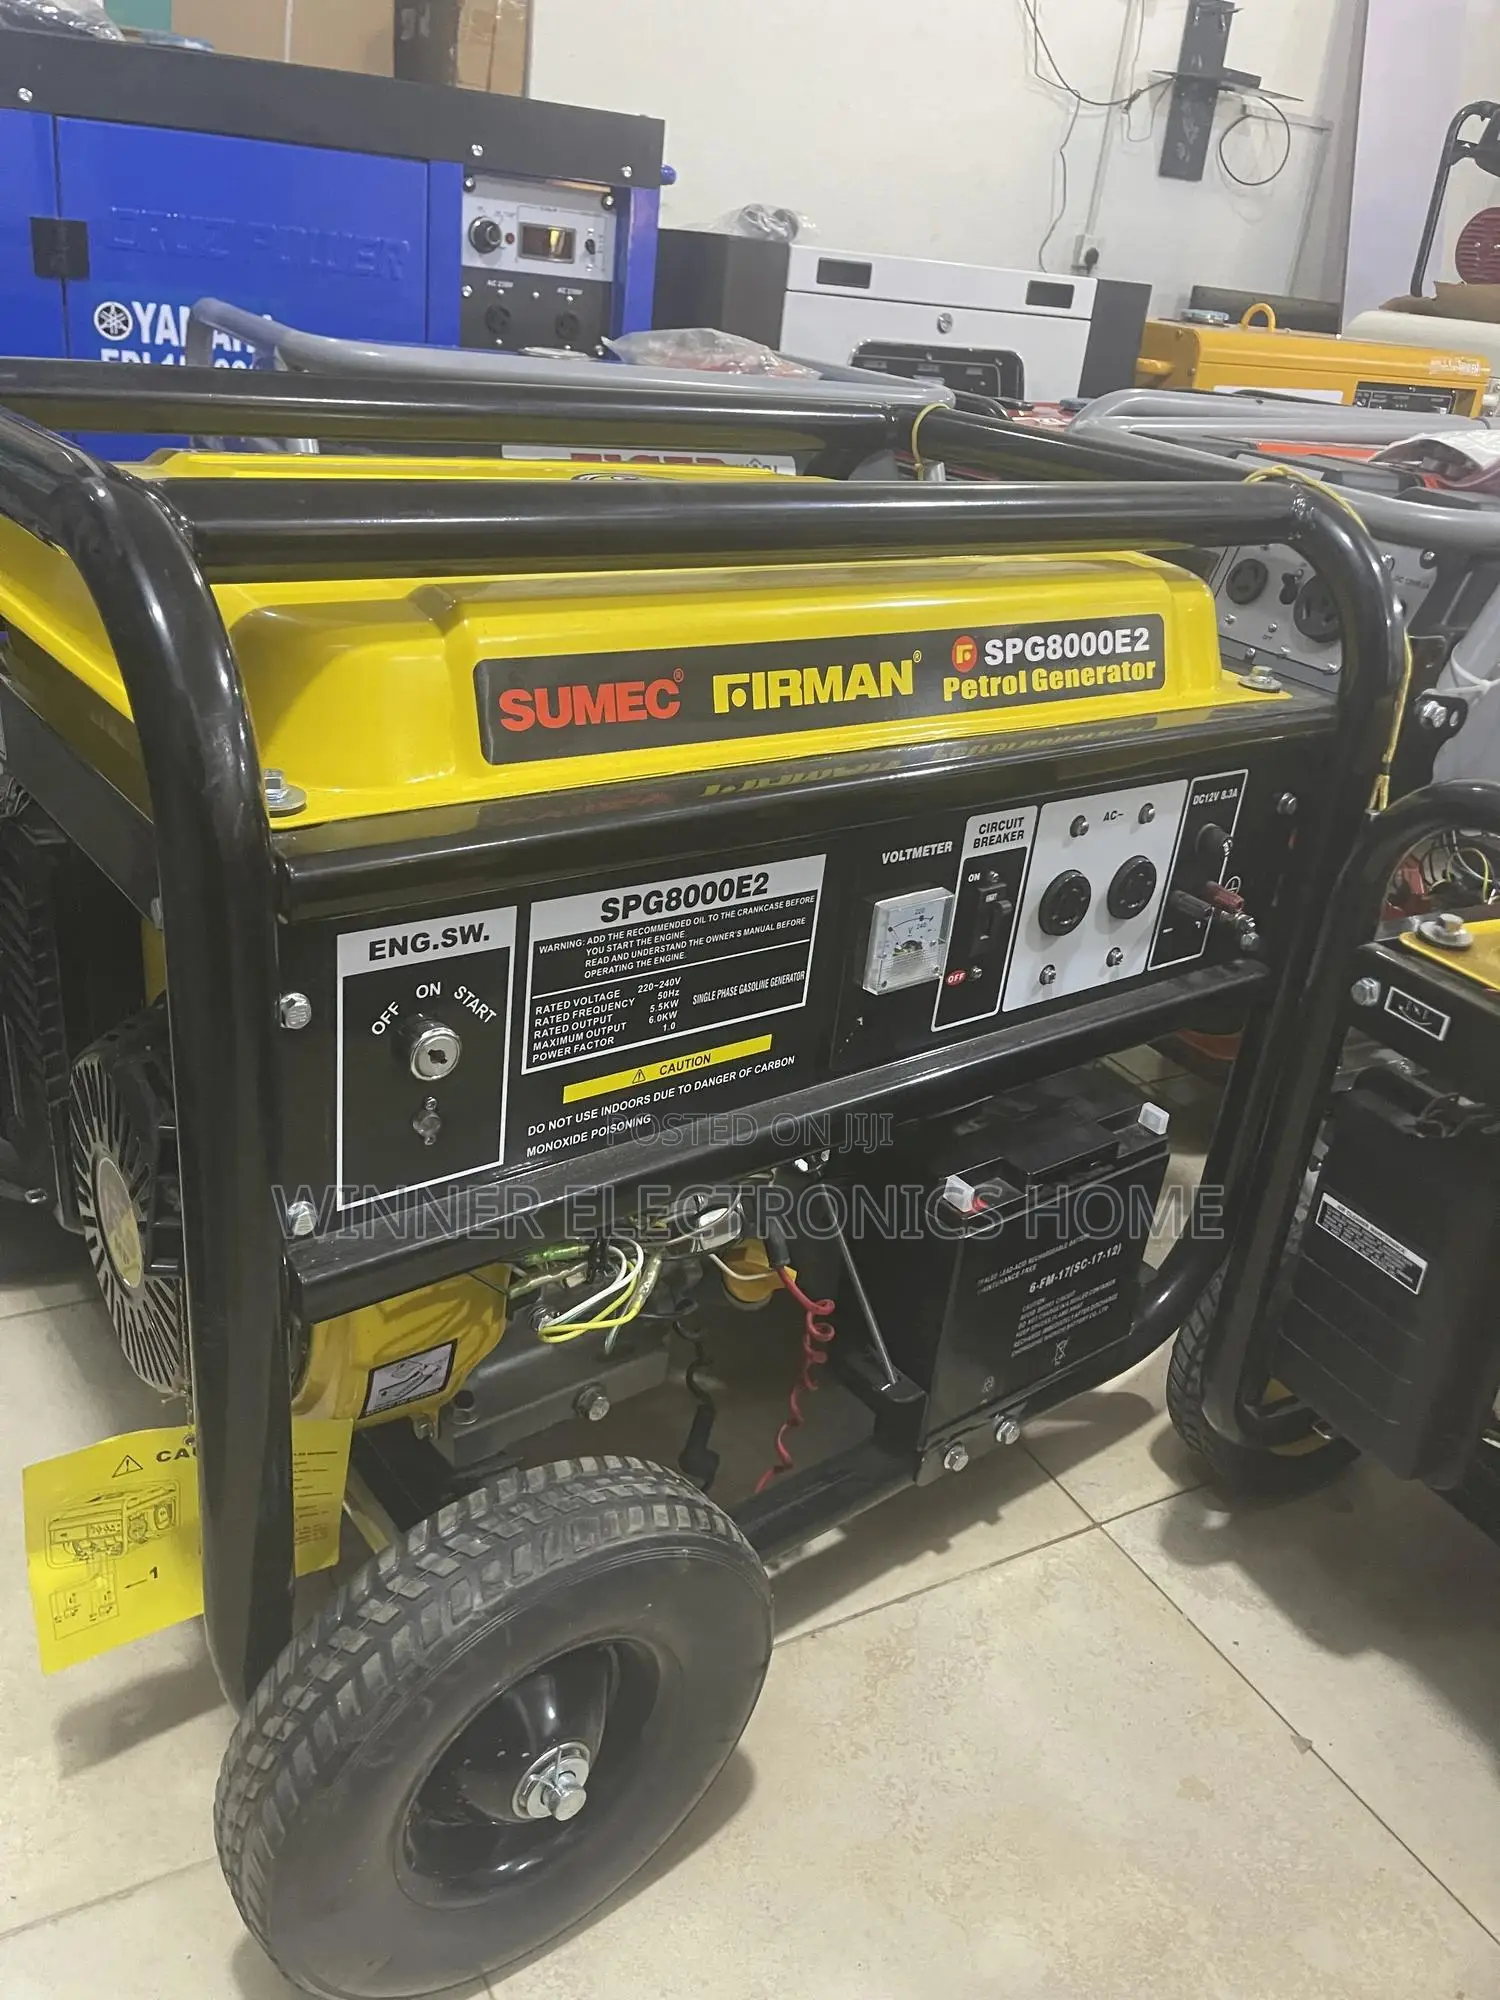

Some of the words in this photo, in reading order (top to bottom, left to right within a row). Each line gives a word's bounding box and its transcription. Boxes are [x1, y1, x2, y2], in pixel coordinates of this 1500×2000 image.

[499, 679, 681, 732] SUMEC
[713, 659, 913, 714] FIRMAN
[984, 627, 1150, 666] SPG8000E2
[943, 671, 1026, 702] Petrol
[1032, 658, 1156, 693] Generator
[973, 830, 1025, 849] BREAKER
[978, 816, 1025, 835] CIRCUIT
[881, 841, 953, 865] VOLTMETER
[968, 872, 981, 883] ON
[600, 872, 770, 923] SPG8000E2
[369, 922, 490, 962] ENG.SW.
[539, 939, 585, 955] WARNING:
[587, 934, 606, 945] ADD
[608, 930, 625, 941] THE
[626, 918, 692, 937] RECOMMENDED
[693, 915, 706, 926] OIL
[708, 913, 719, 923] TO
[721, 910, 736, 920] THE
[737, 901, 784, 917] CRANKCASE
[785, 894, 815, 908] BEFORE
[585, 956, 610, 968] READ
[611, 951, 630, 963] AND
[631, 940, 687, 959] UNDERSTAND
[689, 936, 704, 947] THE
[705, 929, 742, 944] OWNER'S
[743, 922, 775, 937] MANUAL
[776, 917, 806, 930] BEFORE
[586, 945, 605, 957] YOU
[606, 940, 634, 953] START
[636, 936, 652, 947] THE
[584, 961, 634, 979] OPERATING
[636, 957, 653, 969] THE
[692, 990, 716, 1005] SINGLE
[716, 985, 738, 999] PHASE
[739, 978, 769, 994] GASOLINE
[770, 970, 805, 988] GENERATOR
[948, 972, 966, 983] OFF
[416, 982, 441, 999] ON
[453, 985, 497, 1025] START
[534, 1012, 570, 1027] RATED
[572, 997, 635, 1020] FREQUENCY
[657, 988, 680, 1001] 50Hz
[535, 1000, 571, 1015] RATED
[573, 989, 621, 1007] VOLTAGE
[638, 976, 682, 994] 220~240V
[371, 1002, 400, 1036] OFF
[533, 1032, 584, 1051] MAXIMUM
[586, 1022, 627, 1038] OUTPUT
[648, 1010, 678, 1024] 6.0KW
[534, 1024, 569, 1039] RATED
[571, 1013, 613, 1030] OUTPUT
[649, 998, 679, 1013] 5.5KW
[532, 1046, 571, 1063] POWER
[573, 1036, 615, 1053] FACTOR
[662, 1022, 676, 1032] 1.0
[659, 1053, 712, 1076] CAUTION
[527, 1123, 546, 1137] DO
[548, 1115, 572, 1133] NOT
[575, 1108, 599, 1126] USE
[600, 1094, 651, 1118] INDOORS
[653, 1087, 675, 1102] DUE
[677, 1083, 692, 1096] TO
[693, 1071, 736, 1091] DANGER
[738, 1066, 753, 1079] OF
[754, 1055, 795, 1075] CARBON
[526, 1131, 589, 1158] MONOXIDE
[591, 1115, 651, 1140] POISONING
[149, 1566, 159, 1579] 1
